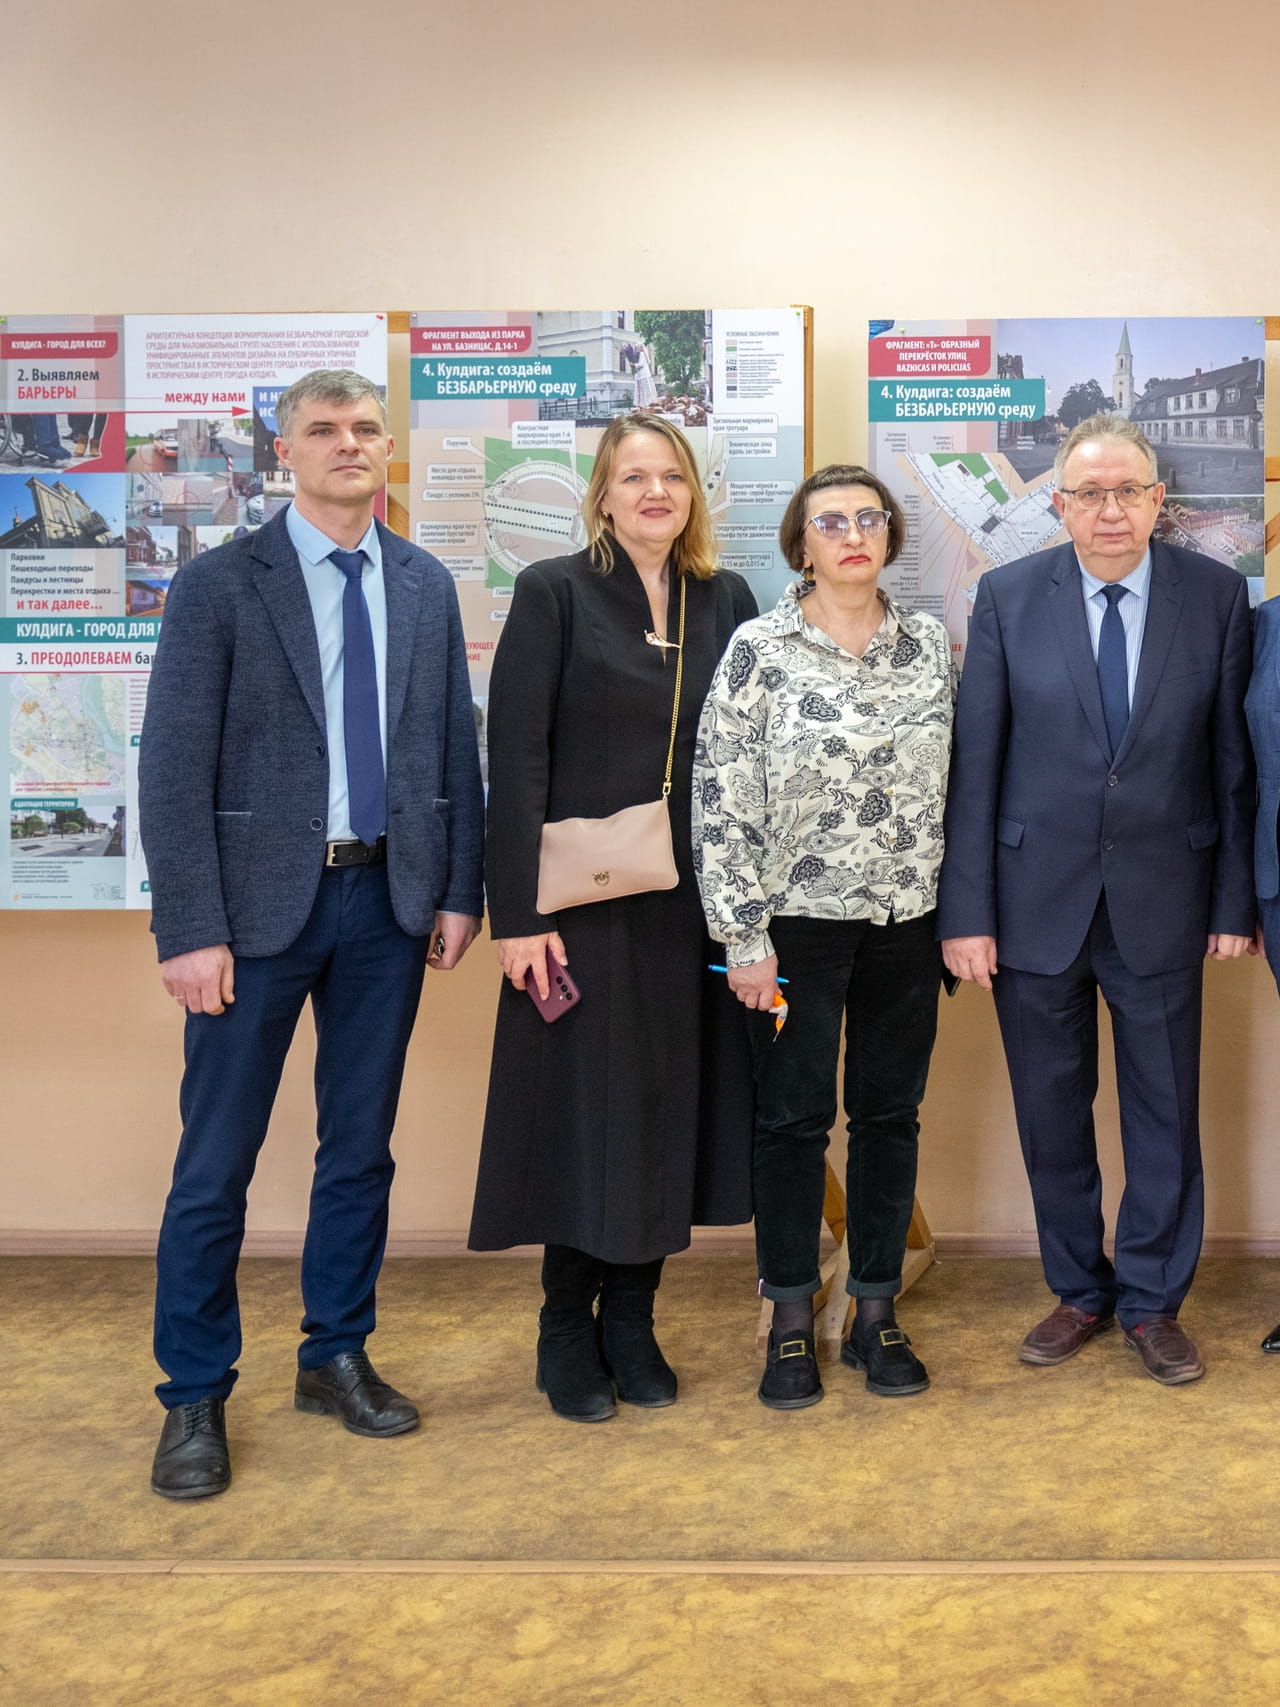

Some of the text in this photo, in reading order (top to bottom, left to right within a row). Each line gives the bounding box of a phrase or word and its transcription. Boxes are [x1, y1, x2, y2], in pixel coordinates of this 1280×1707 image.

[422, 330, 525, 340] ФРАГМЕНТ ВЫХОДА ИЗ ПАРКА
[11, 340, 42, 350] КУЛДИГА
[47, 340, 70, 350] ГОРОД
[70, 340, 85, 350] ДЛЯ
[432, 342, 518, 352] НА УЛ. БАЗНИЦАС, Д.14-1
[886, 341, 925, 349] ФРАГМЕНТ:
[941, 339, 980, 349] ОБРАЗНЫЙ
[899, 351, 967, 361] ПЕРЕКРЁСТОК УЛИЦ
[422, 362, 552, 379] 4. Кулдига: создаём
[896, 364, 930, 372] BAZNICAS
[938, 363, 971, 371] POLICIJAS
[17, 368, 100, 381] 2. Выявляем
[17, 386, 76, 400] БАРЬЕРЫ
[437, 380, 577, 397] БЕЗБАРЬЕРНУЮ среду
[880, 384, 1010, 401] 4. Кулдига: создаём
[164, 392, 246, 406] между нами
[896, 402, 1036, 419] БЕЗБАРЬЕРНУЮ среду
[10, 553, 45, 562] Парковки
[10, 576, 41, 584] Пандусы
[10, 587, 56, 596] Перекрестки
[16, 600, 102, 612] и так далее...
[16, 622, 74, 639] КУЛДИГА
[84, 622, 126, 639] ГОРОД
[128, 622, 155, 639] ДЛЯ
[16, 651, 132, 667] 3. ПРЕОДОЛЕВАЕМ
